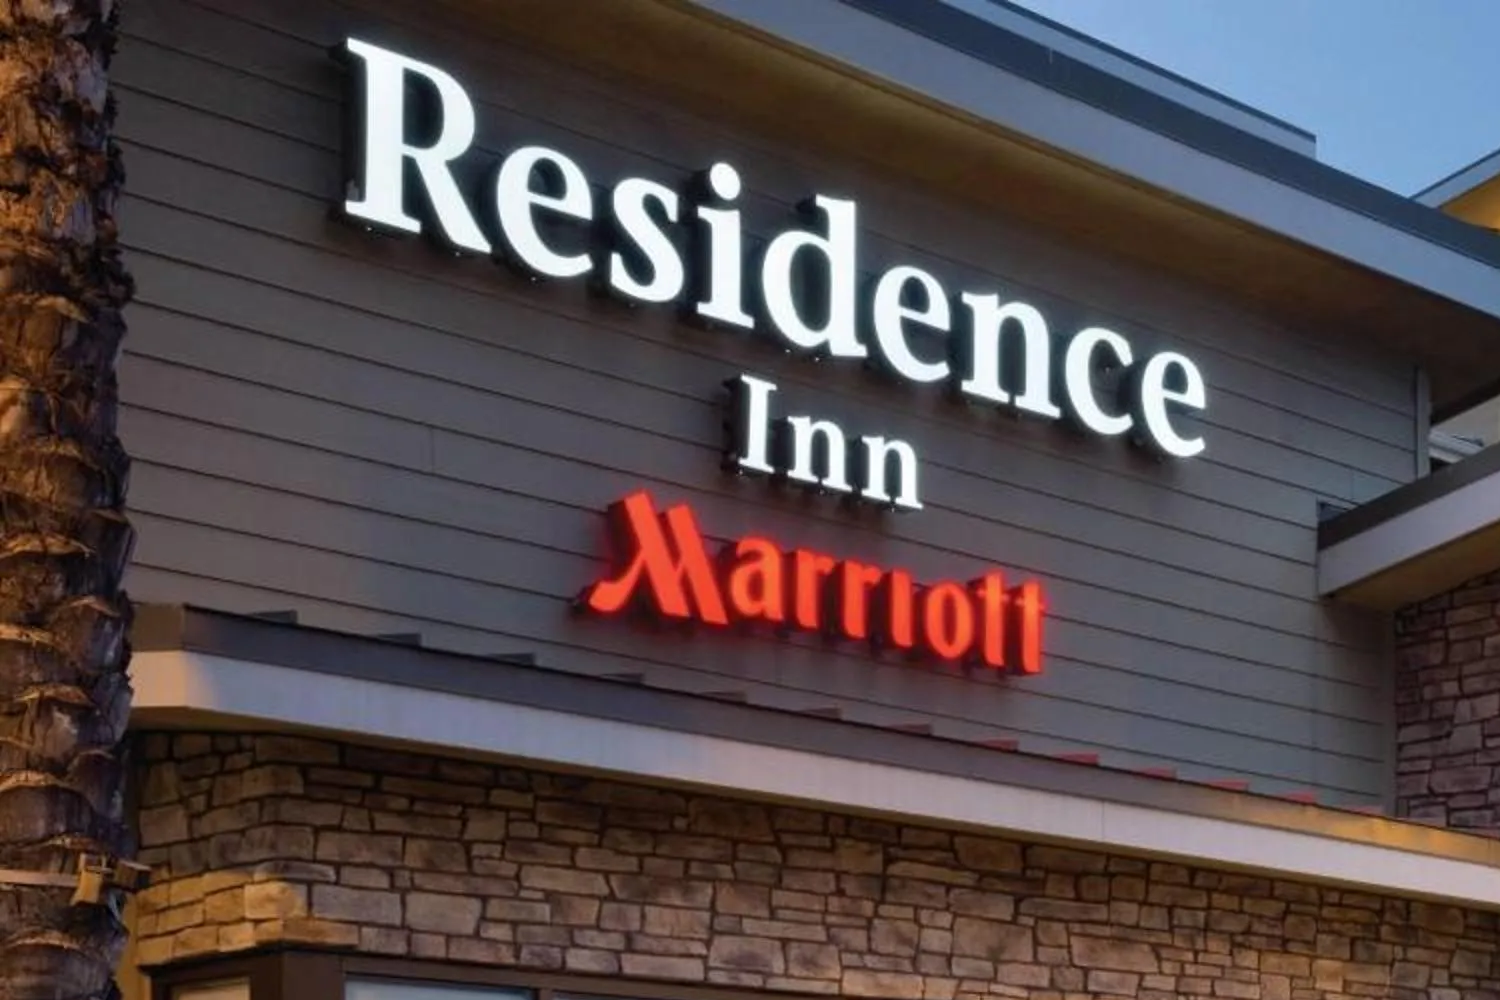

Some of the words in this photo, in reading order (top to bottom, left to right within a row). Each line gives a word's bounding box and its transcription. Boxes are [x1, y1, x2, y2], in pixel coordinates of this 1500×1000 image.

[345, 36, 1207, 459] Residence
[738, 373, 924, 512] Inn
[587, 489, 1047, 676] Marriott
